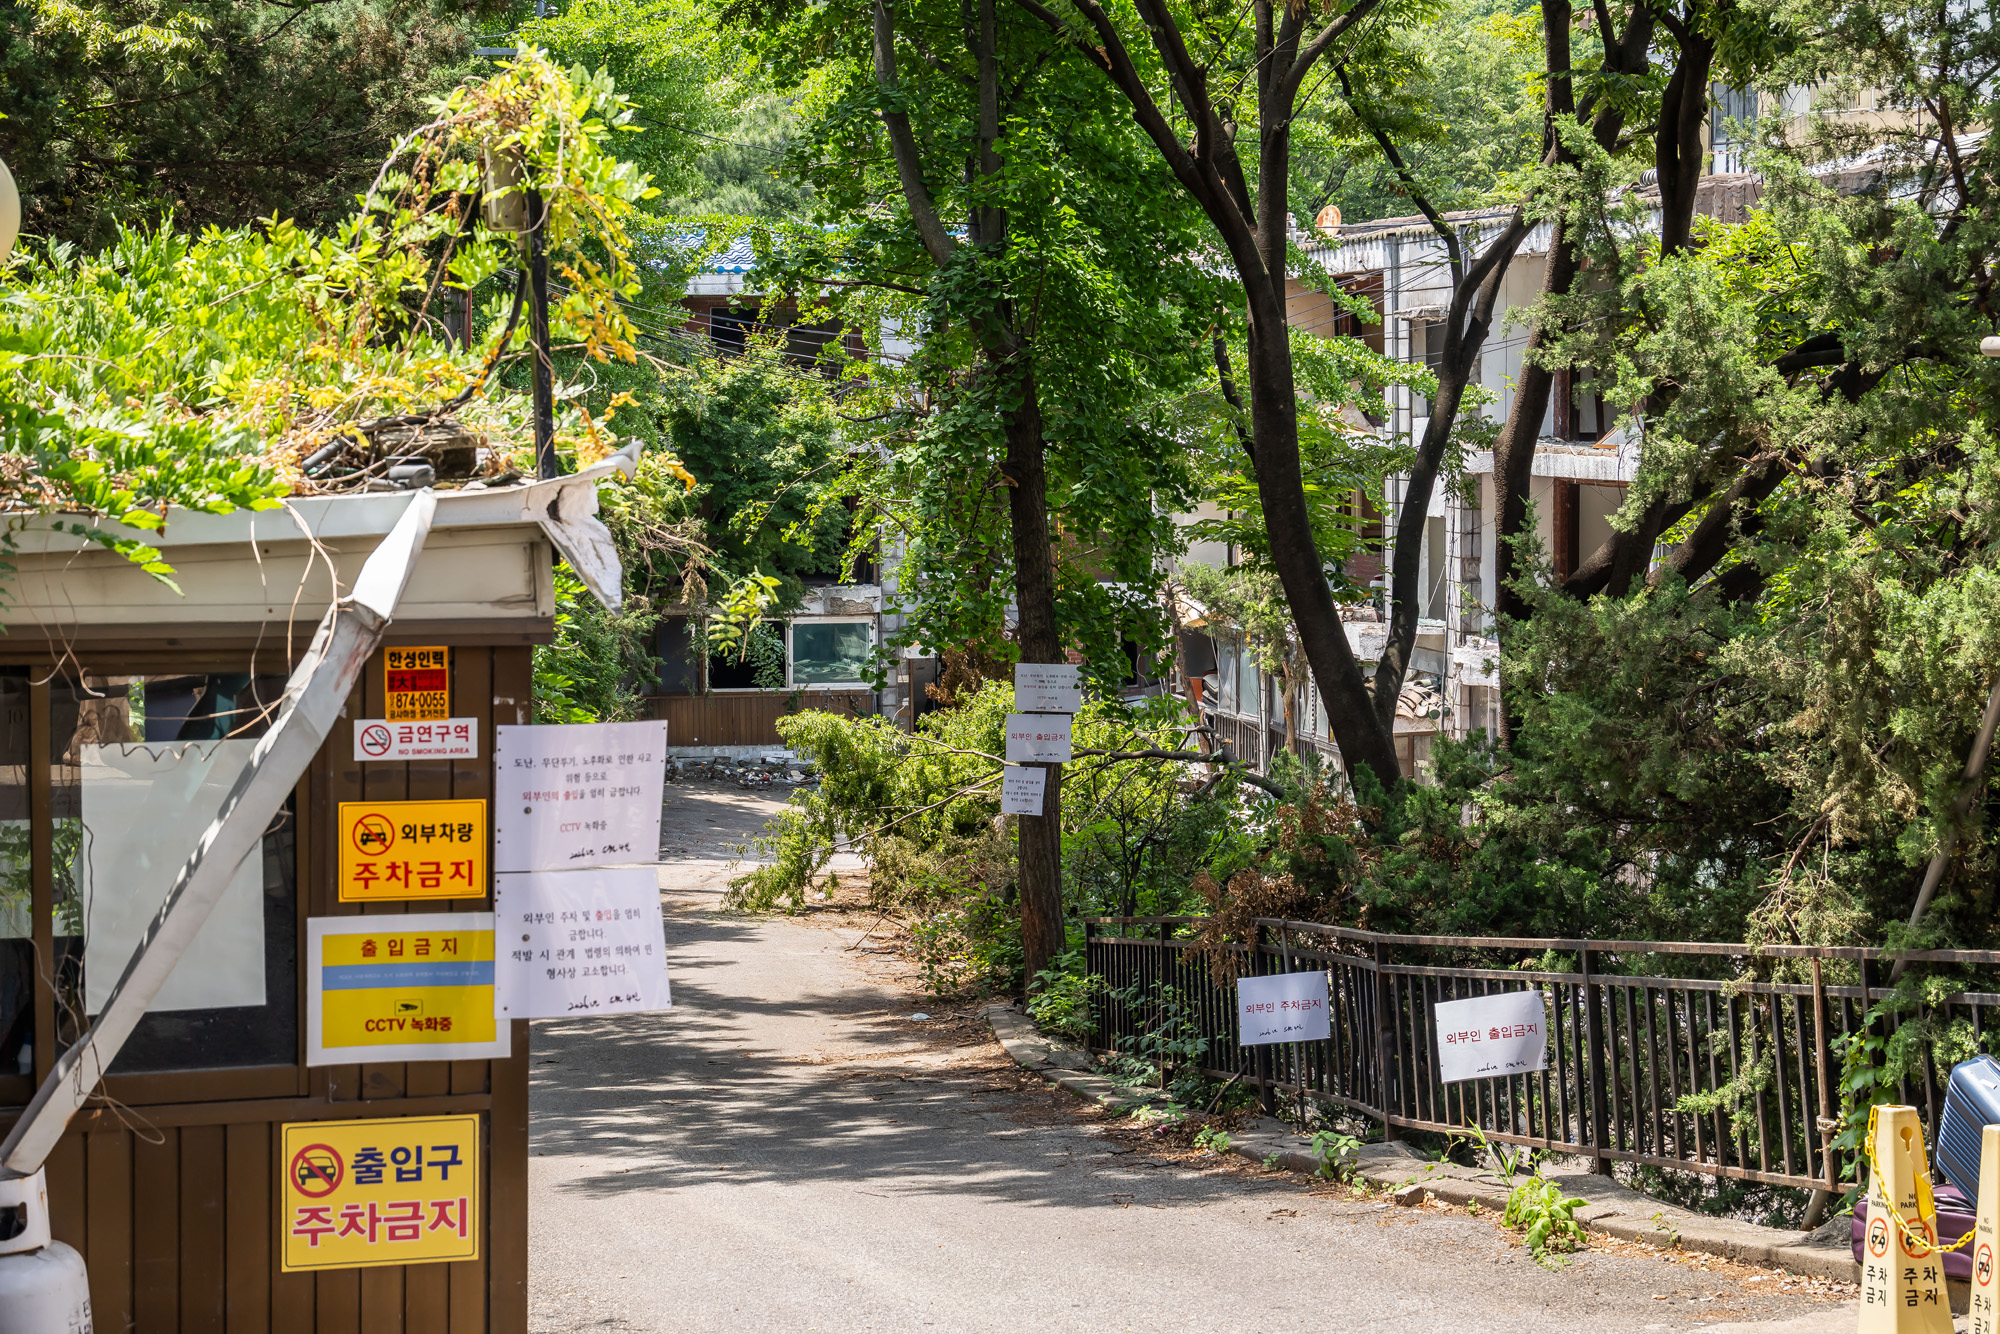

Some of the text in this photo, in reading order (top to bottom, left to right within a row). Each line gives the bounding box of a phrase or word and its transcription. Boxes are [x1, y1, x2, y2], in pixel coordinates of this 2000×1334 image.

[388, 651, 445, 669] 한성인력
[395, 692, 446, 709] 874-0055
[398, 724, 470, 744] 금연구역
[1011, 732, 1066, 742] 외부인 출입금지
[398, 748, 410, 756] NO
[411, 747, 448, 756] SMOKING
[637, 752, 652, 763] 사고
[522, 790, 560, 802] 외부인의
[563, 788, 586, 800] 출입을
[401, 822, 474, 844] 외부차량
[559, 822, 581, 833] CCTV
[352, 859, 474, 890] 주차금지
[523, 911, 555, 925] 외부인
[560, 910, 578, 923] 주차
[595, 907, 621, 921] 출입을
[361, 937, 458, 958] 출입금지
[511, 949, 533, 962] 적발
[539, 948, 550, 961] 시
[546, 963, 629, 980] 형사상 고소합니다.
[1245, 998, 1322, 1015] 외부인 주차금지
[364, 1016, 453, 1033] CCTV 녹화중
[1446, 1022, 1539, 1045] 외부인 출입금지
[351, 1145, 463, 1185] 출입구
[292, 1196, 468, 1248] 주차금지
[1866, 1265, 1888, 1286] 주차
[1903, 1265, 1938, 1286] 주차
[1866, 1286, 1887, 1308] 금지
[1904, 1287, 1938, 1308] 금지
[1974, 1294, 1992, 1317] 주차
